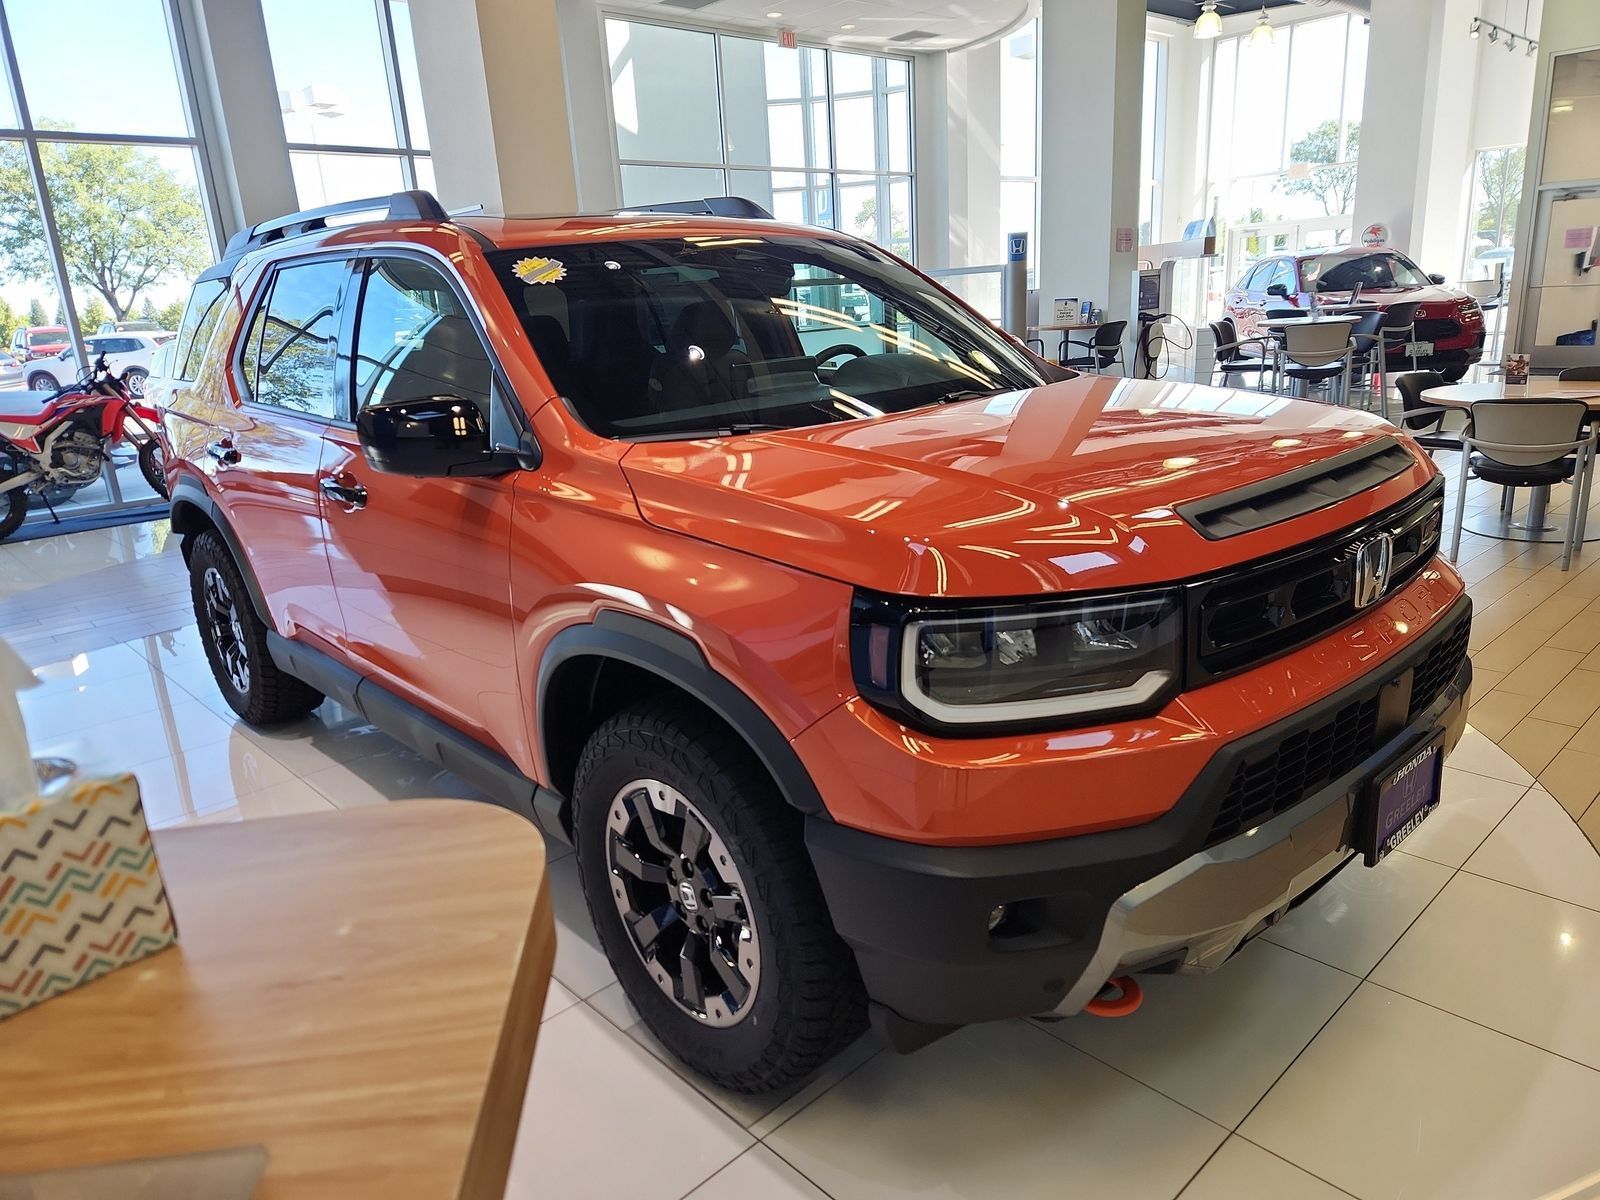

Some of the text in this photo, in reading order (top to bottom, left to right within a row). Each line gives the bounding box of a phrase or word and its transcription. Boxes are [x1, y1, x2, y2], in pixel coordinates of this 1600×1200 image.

[1397, 746, 1432, 780] HONDA
[1386, 785, 1426, 828] GREELEY
[1390, 808, 1424, 848] GREELEY
